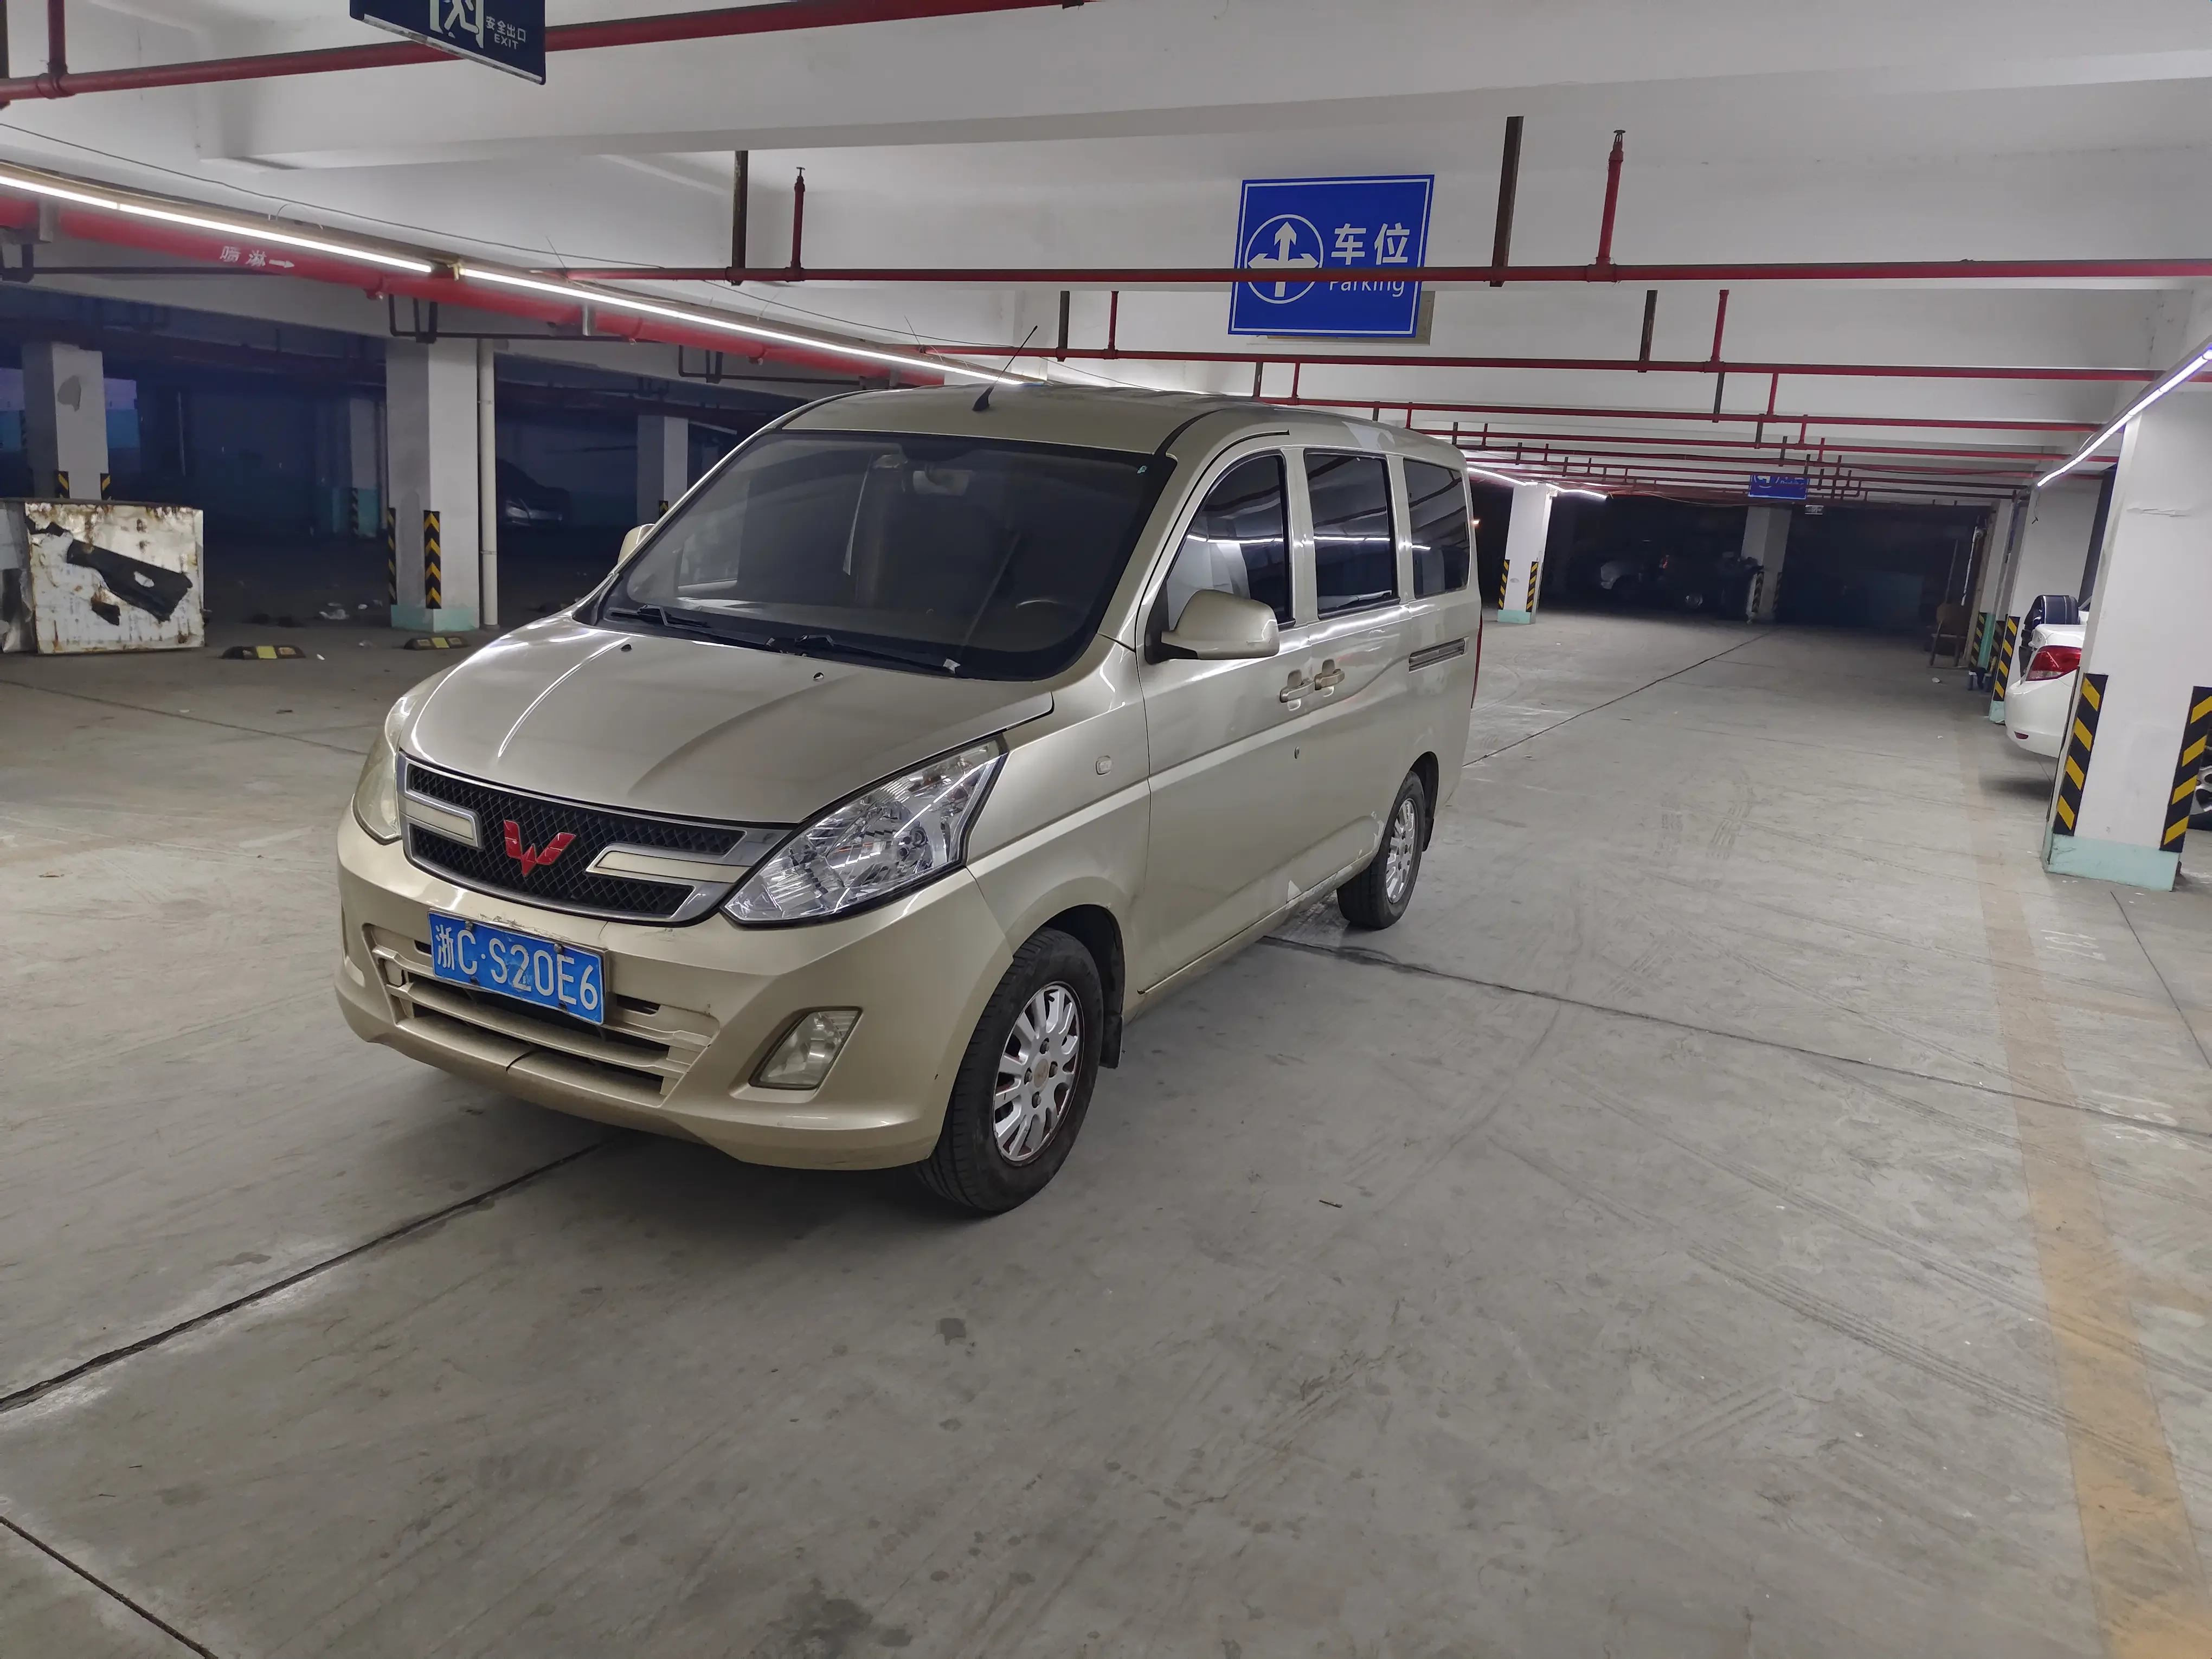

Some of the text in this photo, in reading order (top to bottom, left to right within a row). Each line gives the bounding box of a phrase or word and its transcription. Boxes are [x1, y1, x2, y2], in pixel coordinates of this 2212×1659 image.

[486, 15, 526, 43] 安全出口
[494, 33, 519, 50] EXIT
[1331, 222, 1410, 266] 车位
